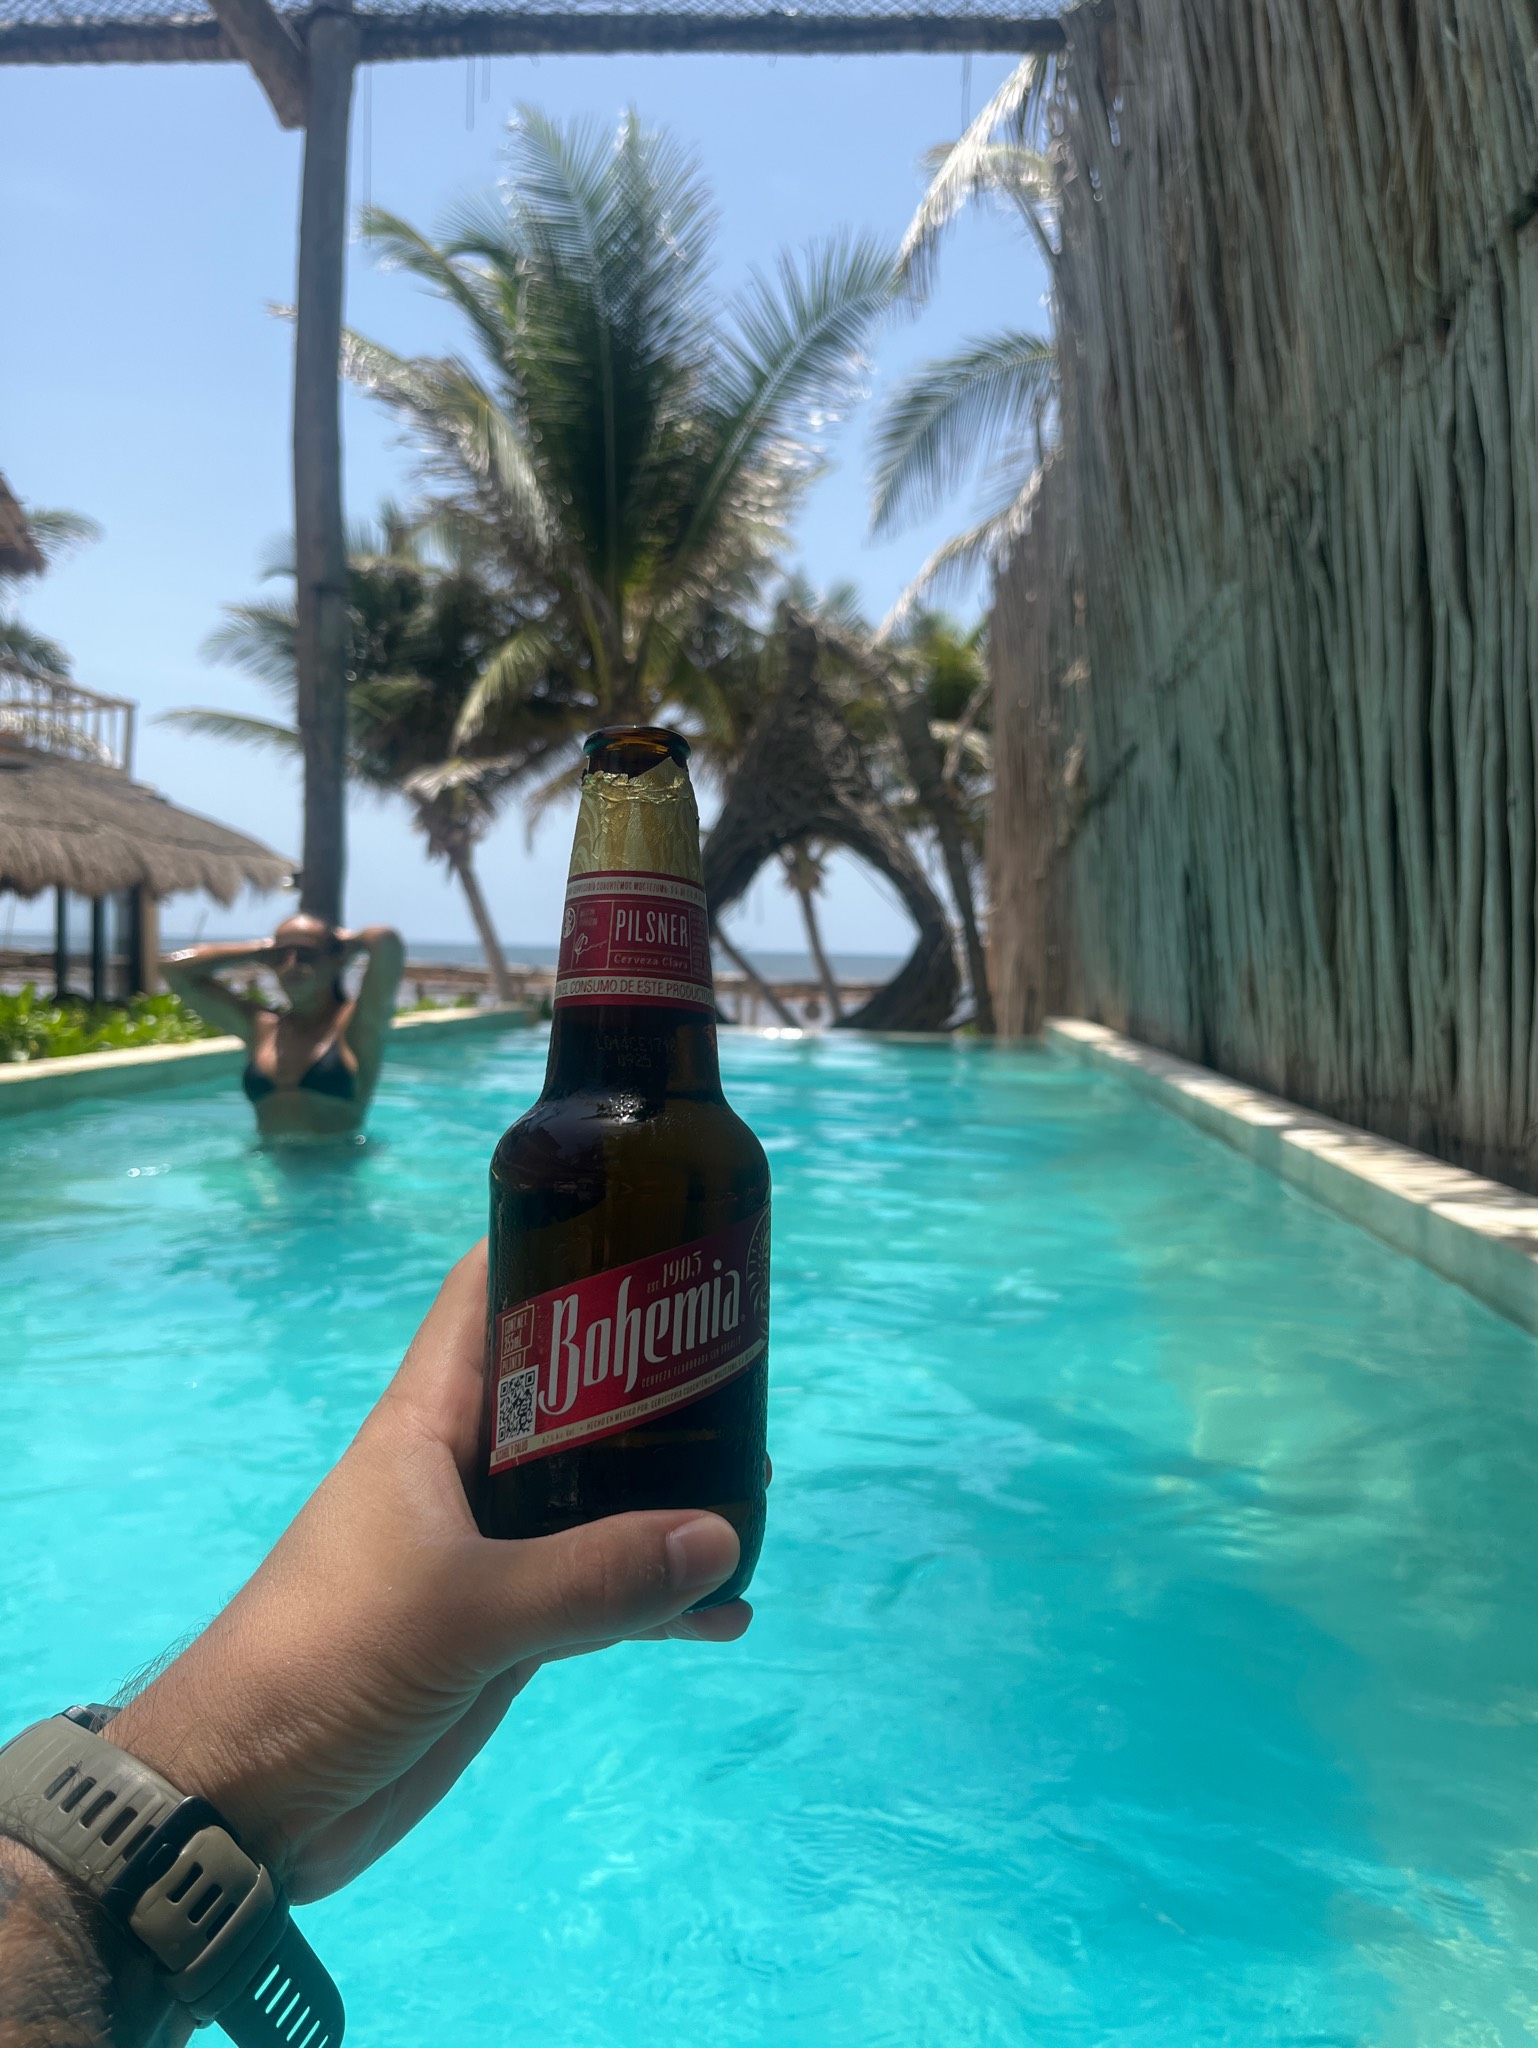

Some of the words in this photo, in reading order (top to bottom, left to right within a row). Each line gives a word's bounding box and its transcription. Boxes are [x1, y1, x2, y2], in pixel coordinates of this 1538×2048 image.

[615, 909, 688, 947] PILSNER
[614, 953, 658, 966] Cerveza
[662, 956, 688, 969] Clara
[570, 979, 617, 994] CONSUMO
[620, 979, 633, 993] DE
[637, 979, 663, 994] ESTE
[663, 1250, 702, 1288] 1905
[538, 1259, 740, 1415] Bohemia
[641, 1370, 671, 1388] CERVEZA
